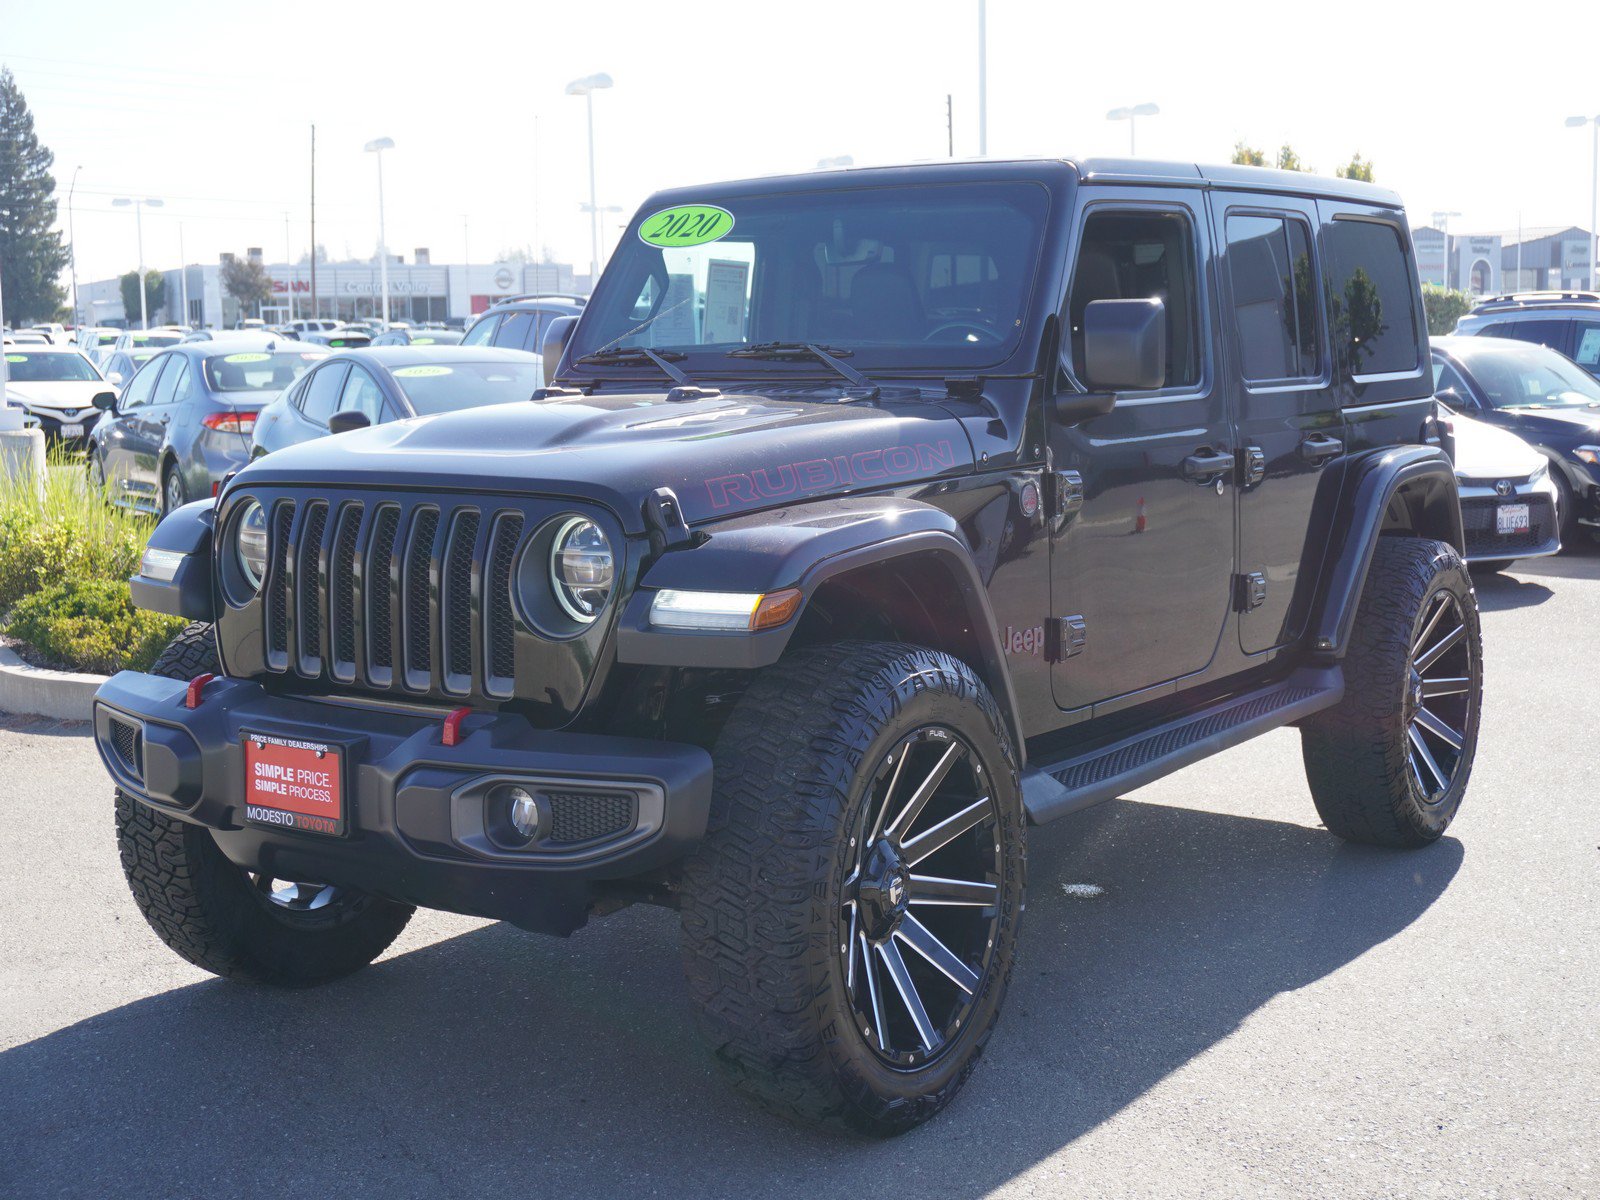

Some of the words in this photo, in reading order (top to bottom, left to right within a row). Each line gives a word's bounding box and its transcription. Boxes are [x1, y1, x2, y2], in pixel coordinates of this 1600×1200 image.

[649, 212, 722, 238] 2020
[272, 280, 310, 293] SAN
[345, 281, 393, 292] Centrl
[704, 440, 955, 508] RUBICON
[1003, 626, 1045, 656] Jeep
[250, 734, 267, 743] PRICE
[267, 737, 287, 746] FAMILY
[288, 740, 328, 752] DEALERSHIPS
[929, 729, 948, 739] FUEL
[254, 762, 294, 781] SIMPLE
[297, 769, 332, 787] PRICE.
[255, 779, 287, 795] SIMPLE
[289, 785, 333, 803] PROCESS.
[247, 806, 293, 826] MODESTO
[296, 815, 335, 833] TOYOTA
